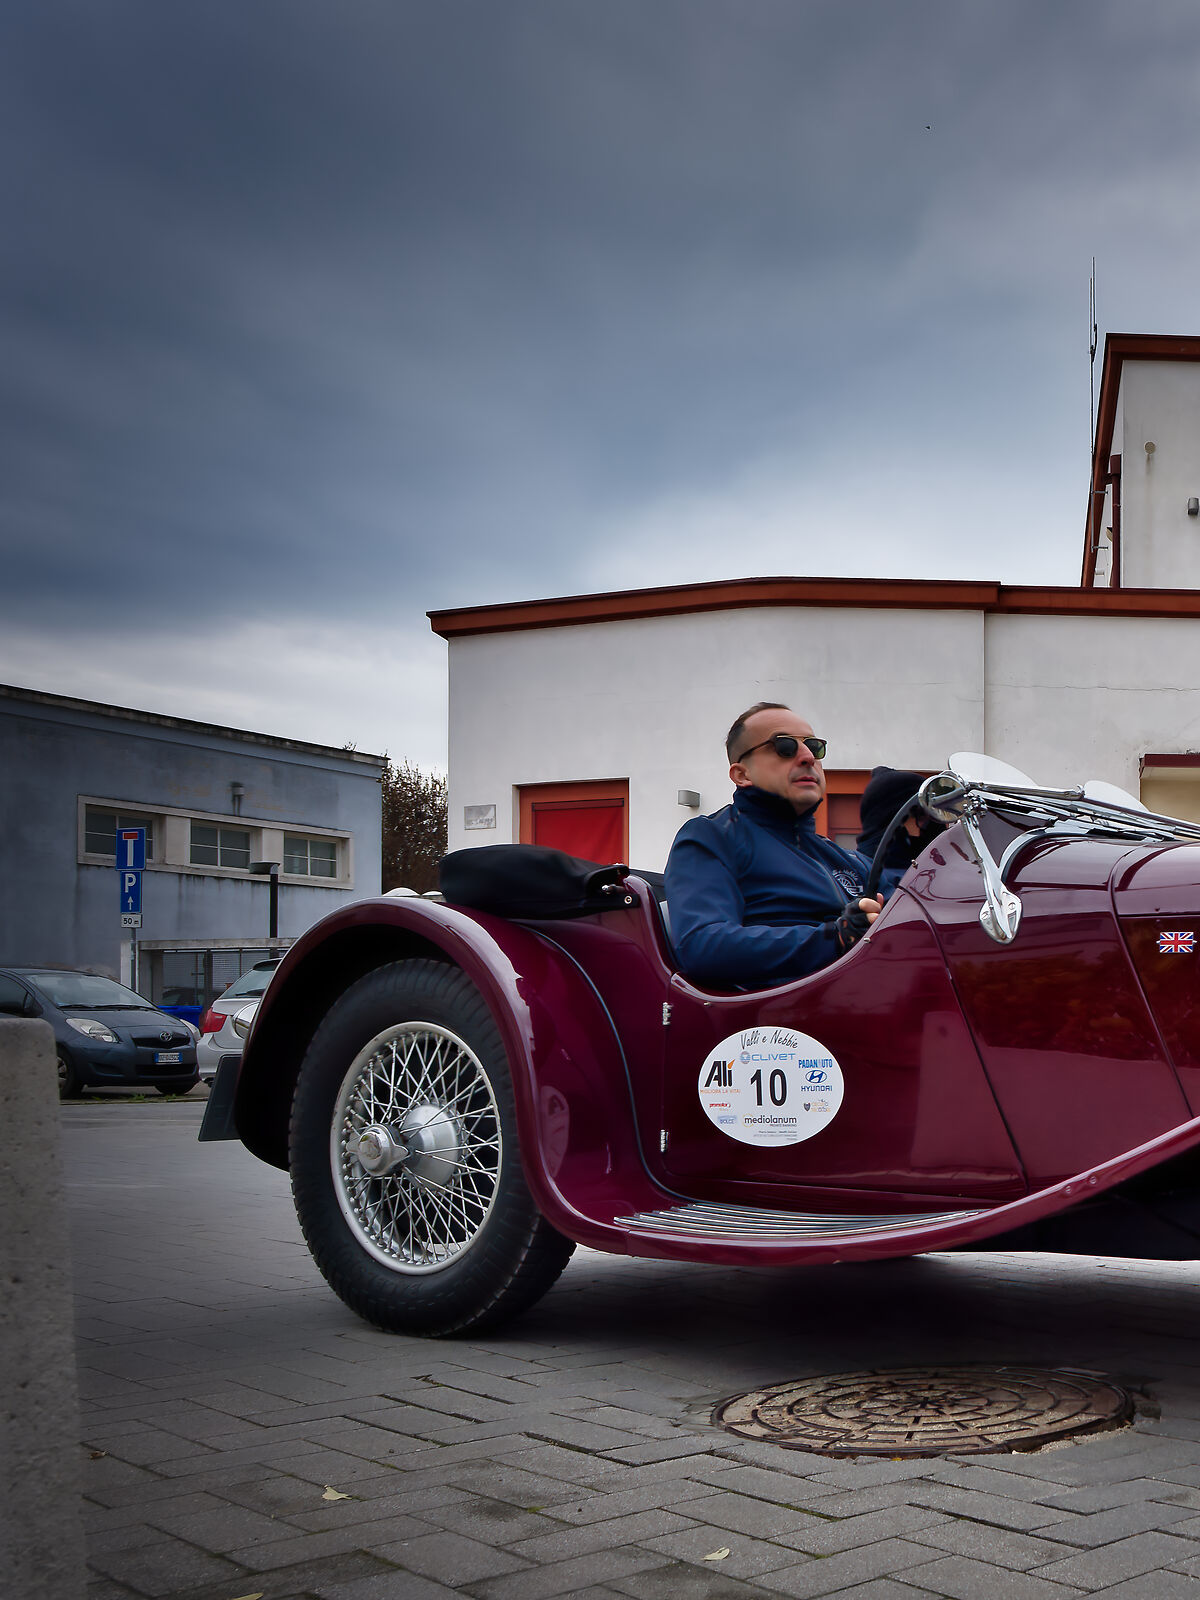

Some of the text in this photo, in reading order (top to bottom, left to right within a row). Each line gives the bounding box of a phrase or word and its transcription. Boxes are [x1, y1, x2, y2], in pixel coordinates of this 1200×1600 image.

[124, 873, 137, 893] P
[123, 917, 133, 925] 50
[770, 1029, 799, 1049] Nebbie
[750, 1068, 788, 1107] 10
[744, 1115, 797, 1124] mediolanum
